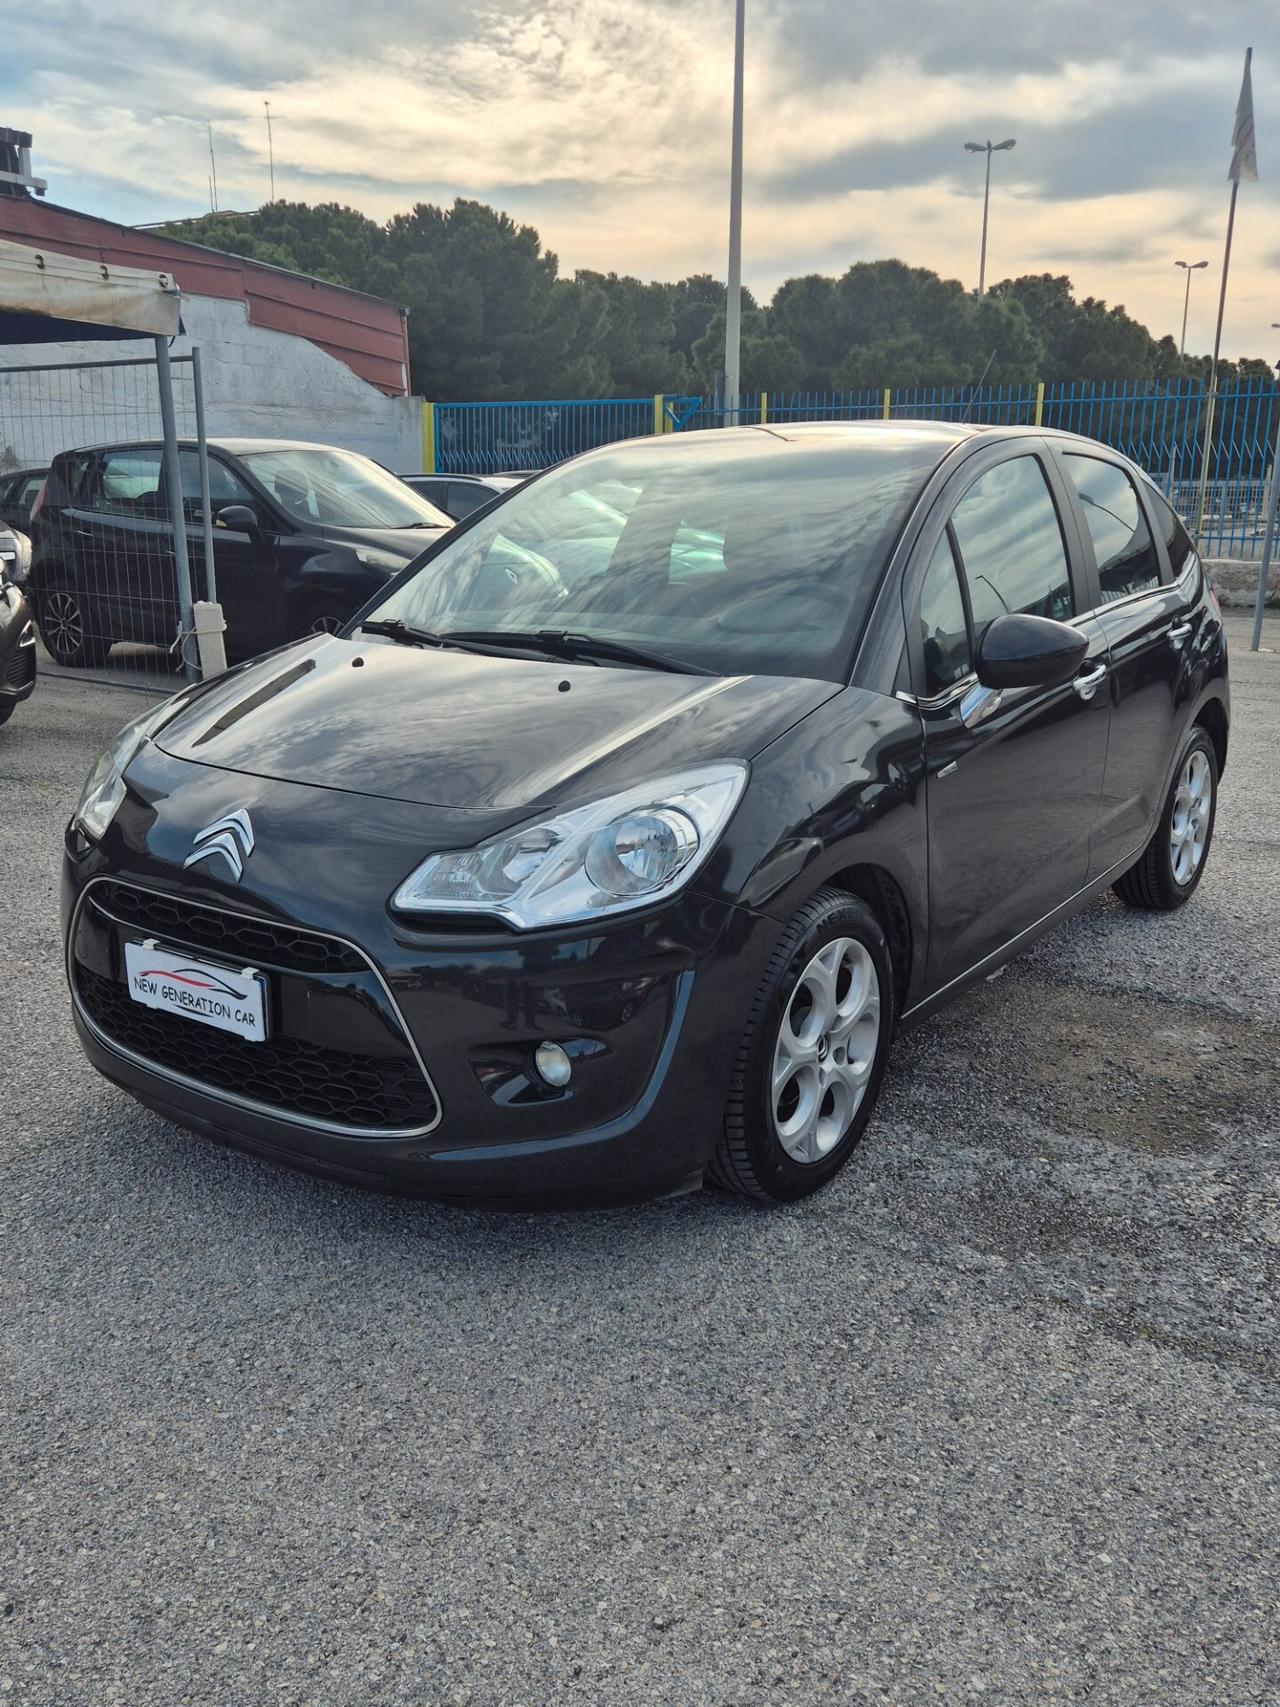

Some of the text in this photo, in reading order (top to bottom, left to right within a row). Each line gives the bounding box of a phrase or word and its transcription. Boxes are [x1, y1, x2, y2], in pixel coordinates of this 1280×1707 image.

[134, 977, 256, 1028] NEW GENERATION CAR
